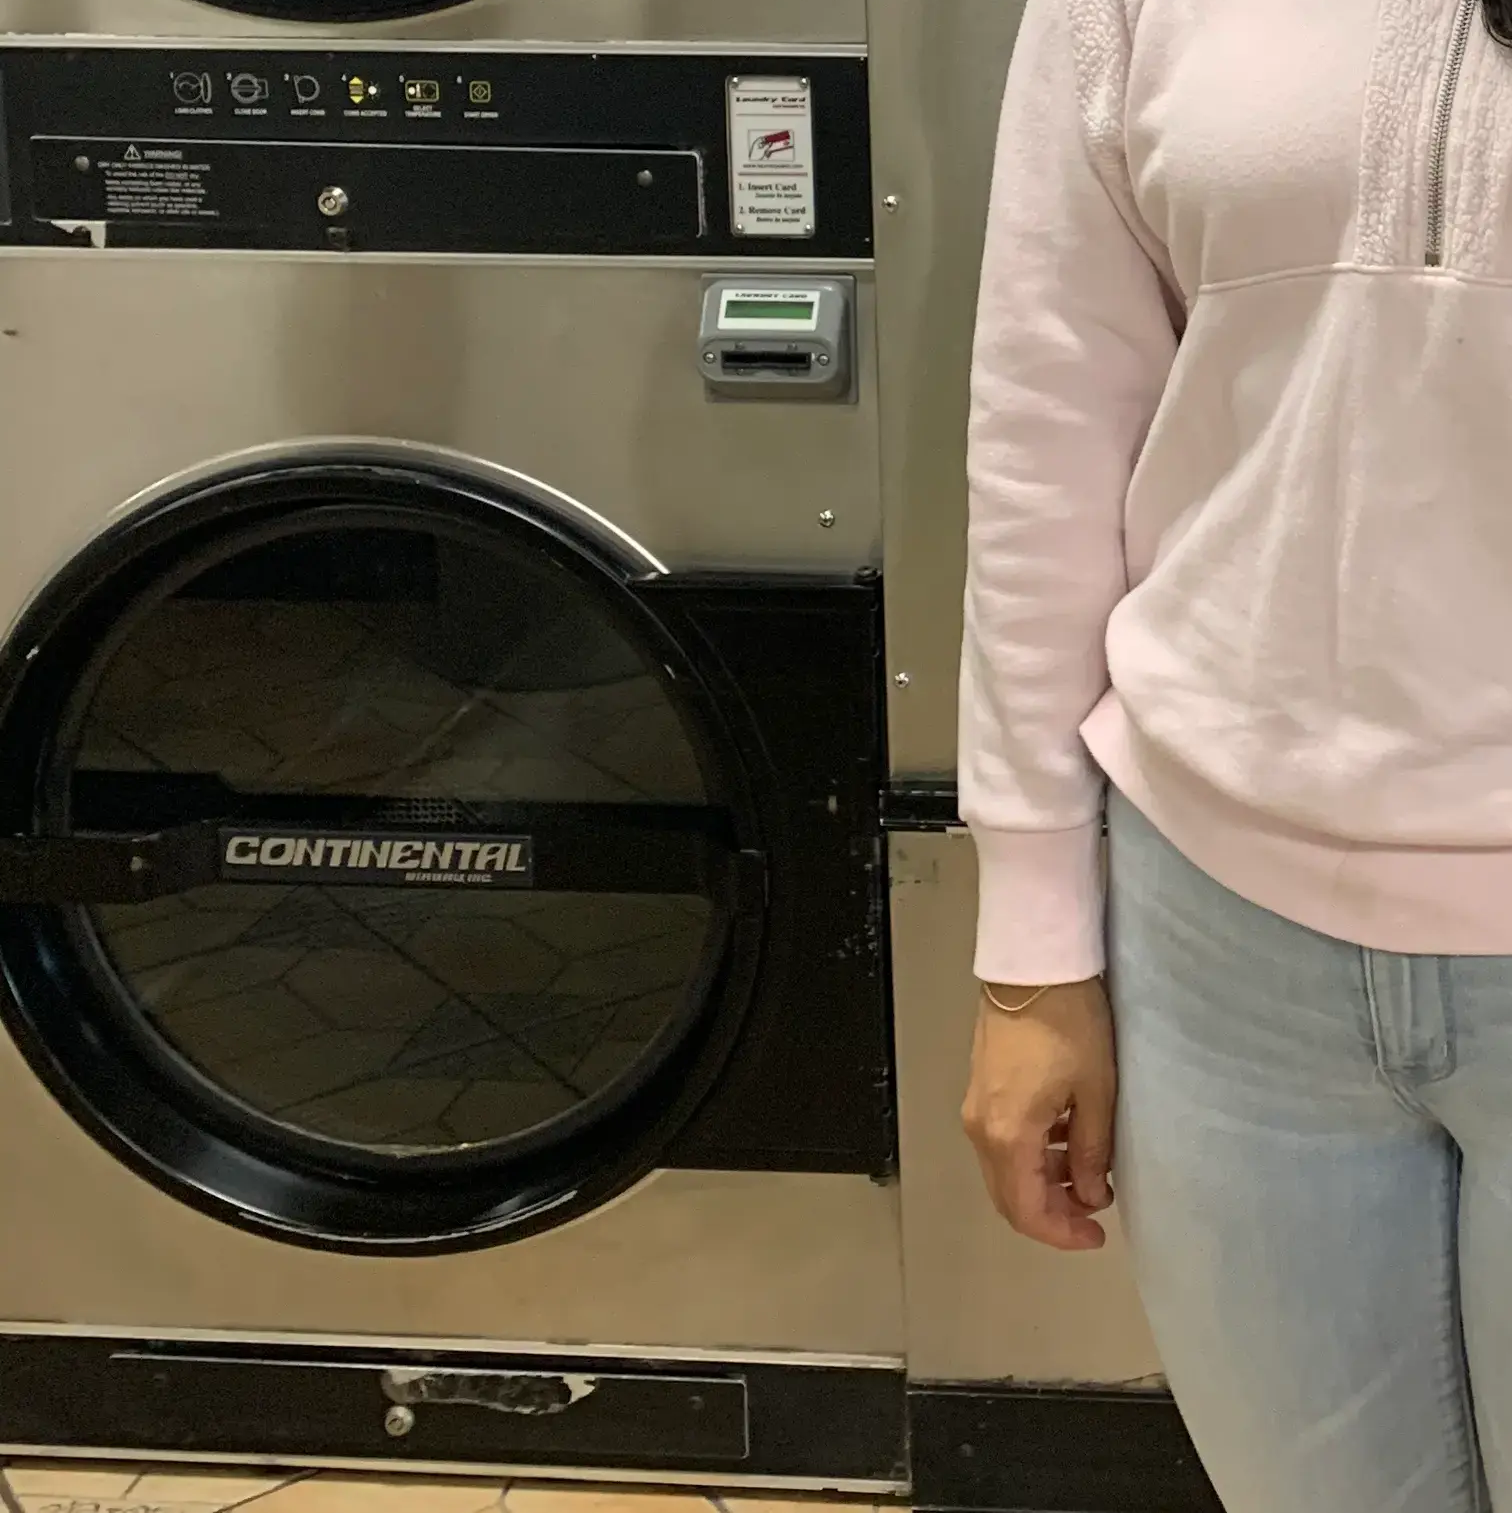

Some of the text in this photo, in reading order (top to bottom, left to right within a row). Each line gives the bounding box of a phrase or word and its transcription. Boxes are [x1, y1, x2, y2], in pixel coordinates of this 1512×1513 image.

[775, 182, 797, 191] Card
[748, 206, 781, 215] Remove
[784, 206, 806, 215] Card
[225, 836, 527, 872] CONTINENTAL
